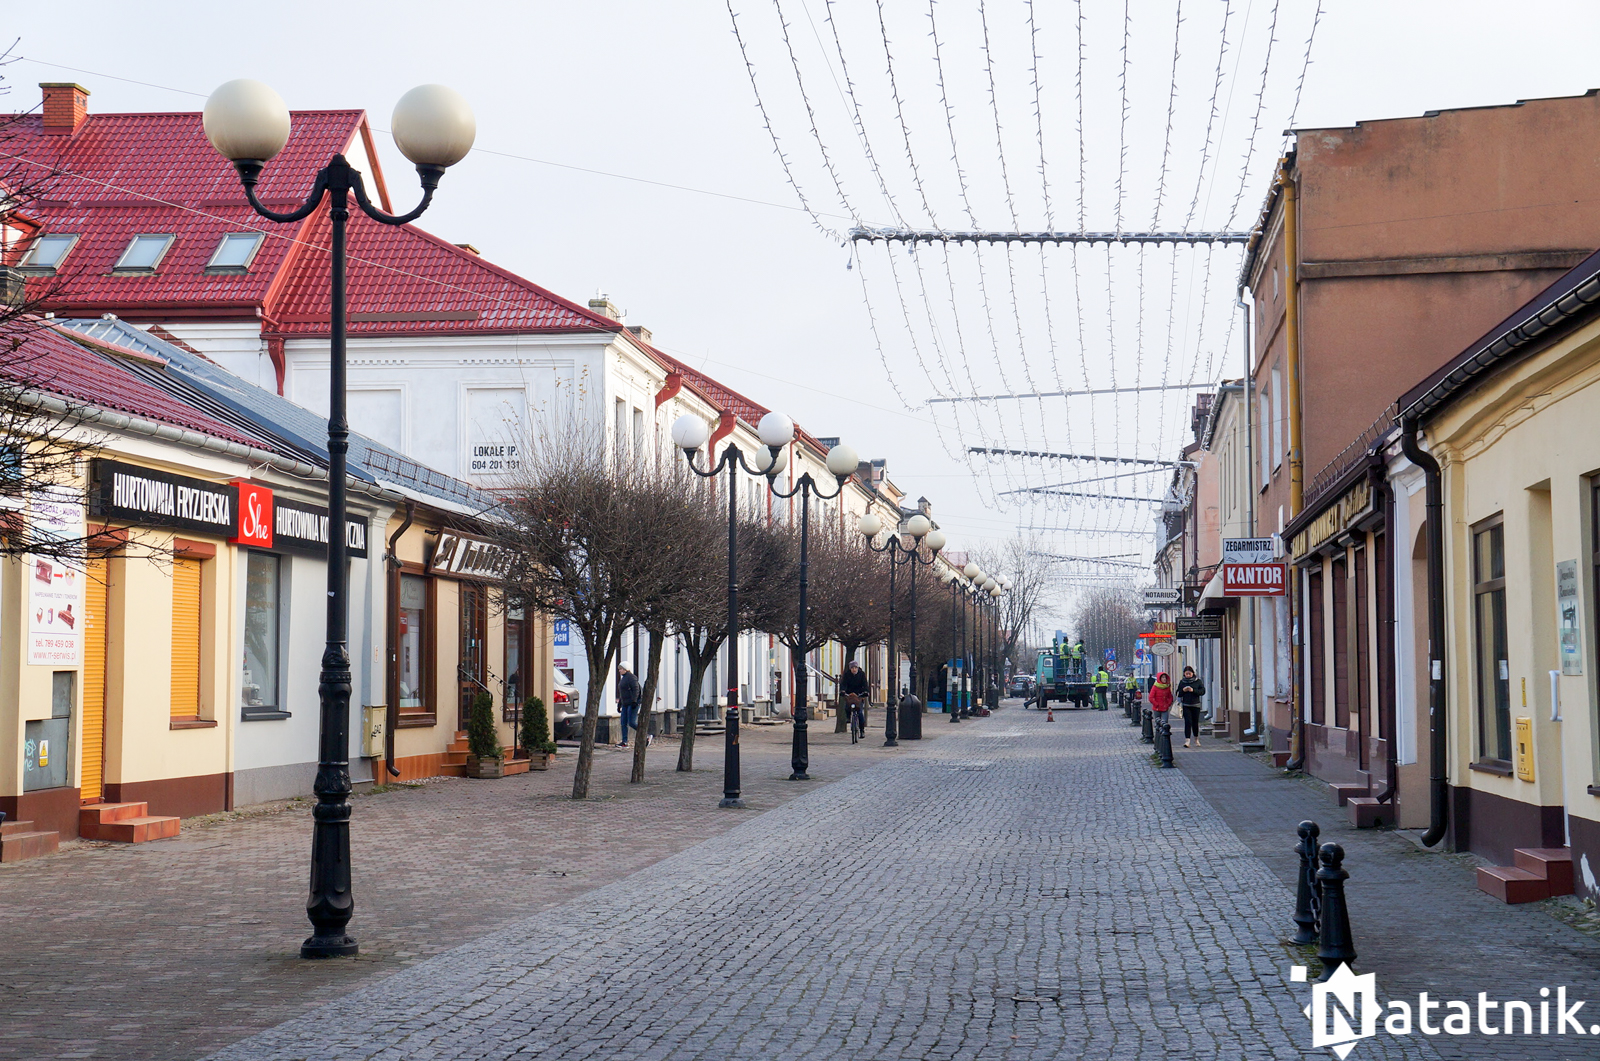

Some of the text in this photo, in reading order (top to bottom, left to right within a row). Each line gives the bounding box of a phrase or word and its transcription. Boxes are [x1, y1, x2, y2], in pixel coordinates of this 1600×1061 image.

[474, 446, 504, 456] LOKALE
[472, 460, 520, 470] 604 201 131
[113, 472, 230, 526] HURTOWNIA FRYZJERSKA
[243, 492, 269, 540] She
[276, 505, 366, 550] HURTOWNIA KOYCZNA
[1225, 541, 1271, 552] ZEGARMISTRZ
[1226, 566, 1282, 584] KANTOR
[1145, 591, 1178, 599] NOTARIUSZ
[1154, 622, 1176, 631] KANTO
[35, 638, 44, 647] tel.
[45, 639, 54, 648] 789
[55, 640, 64, 648] 459
